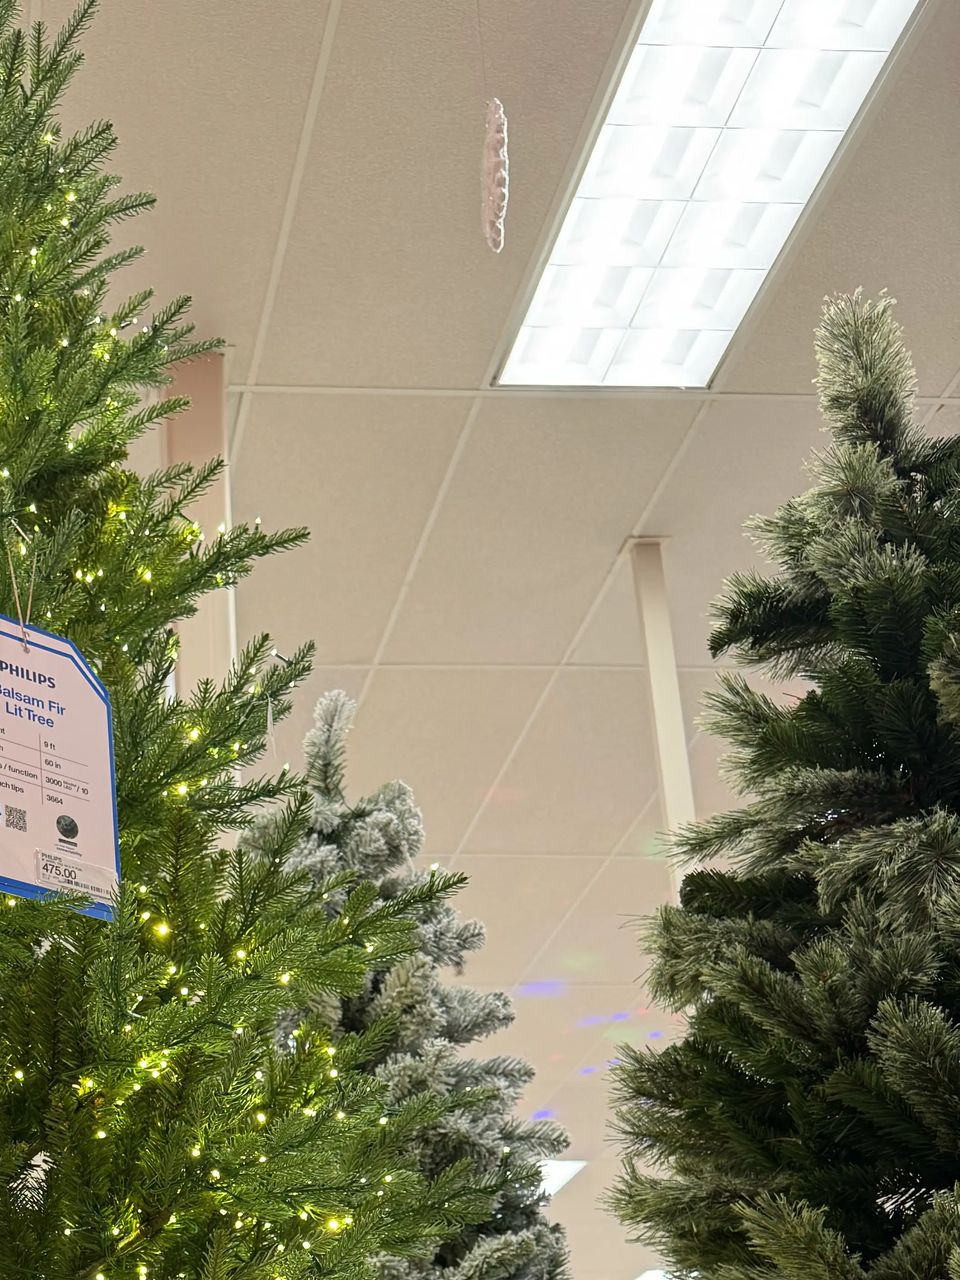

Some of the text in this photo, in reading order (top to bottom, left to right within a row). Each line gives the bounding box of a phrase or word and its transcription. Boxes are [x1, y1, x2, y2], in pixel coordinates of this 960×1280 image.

[0, 660, 56, 689] PHILIPS
[5, 702, 54, 728] Lit Tree
[48, 700, 66, 716] Fir
[43, 741, 56, 751] 9 ft
[8, 765, 38, 780] function
[54, 760, 61, 770] in
[11, 783, 24, 794] tips
[45, 776, 63, 788] 3000
[42, 863, 77, 880] 475.00
